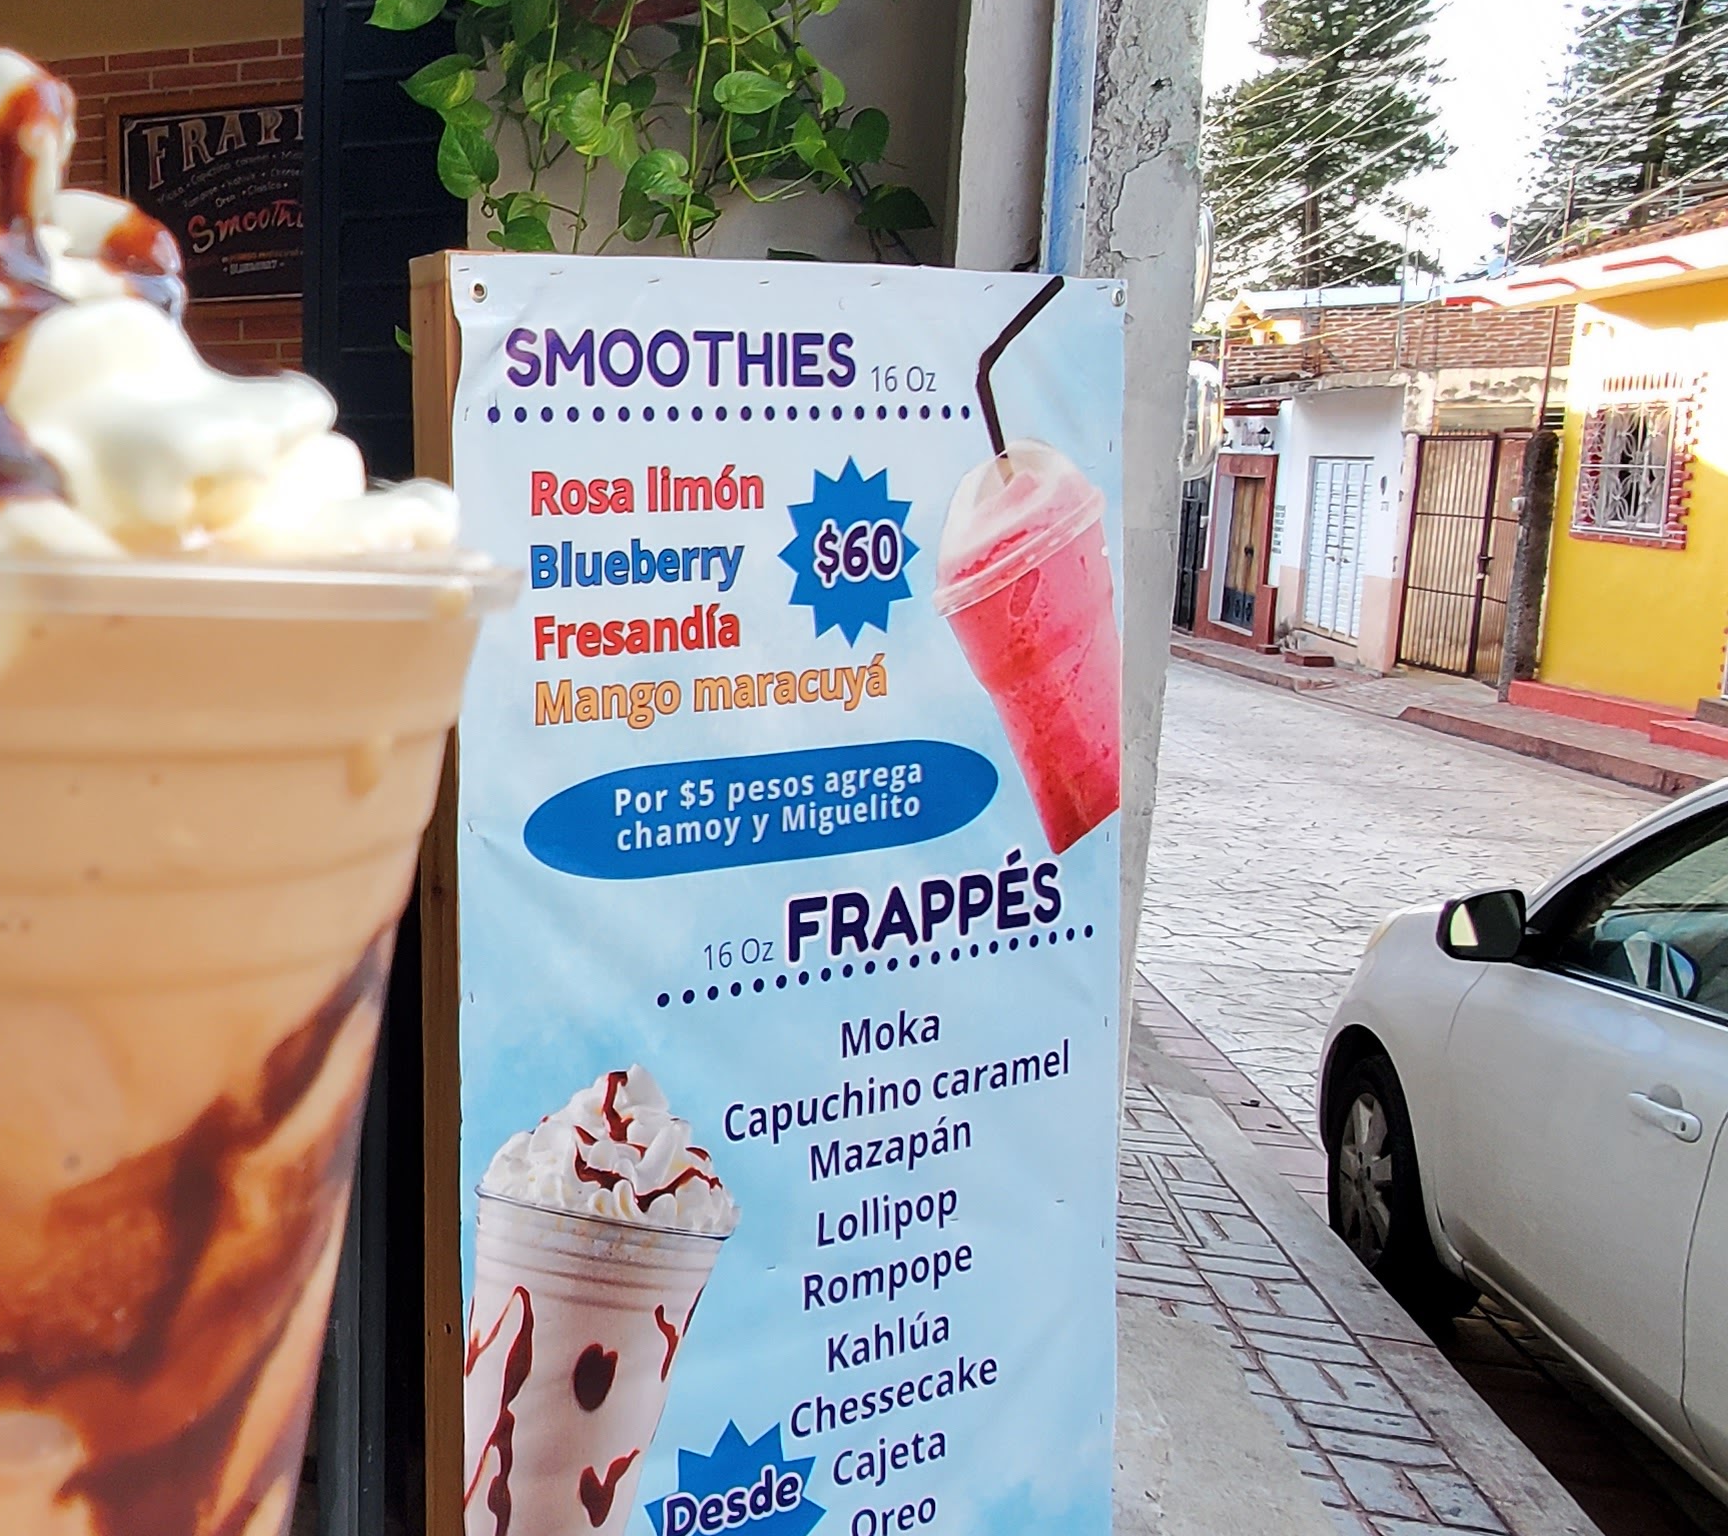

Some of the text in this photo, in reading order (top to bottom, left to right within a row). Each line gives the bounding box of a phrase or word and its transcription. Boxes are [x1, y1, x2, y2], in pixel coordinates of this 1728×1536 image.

[506, 328, 937, 393] SMOOTHIES 16 Oz
[531, 465, 764, 516] Rosa limón
[530, 539, 744, 592] Blueberry
[815, 522, 900, 586] $60
[534, 604, 740, 660] Fresandía
[535, 654, 888, 729] Mango maracuyá
[614, 762, 923, 817] Por $5 pesos agrega
[617, 792, 921, 852] chamoy y Miguelito
[704, 848, 1062, 970] 16 Oz FRAPPÉS
[841, 1010, 941, 1059] Moka
[724, 1039, 1070, 1144] Capuchino caramel
[810, 1117, 972, 1182] Mazapán
[817, 1187, 958, 1247] Lollipop
[802, 1243, 973, 1311] Rompope
[827, 1311, 950, 1373] Kahlúa
[790, 1357, 998, 1438] Chessecake
[832, 1430, 947, 1487] Cajeta
